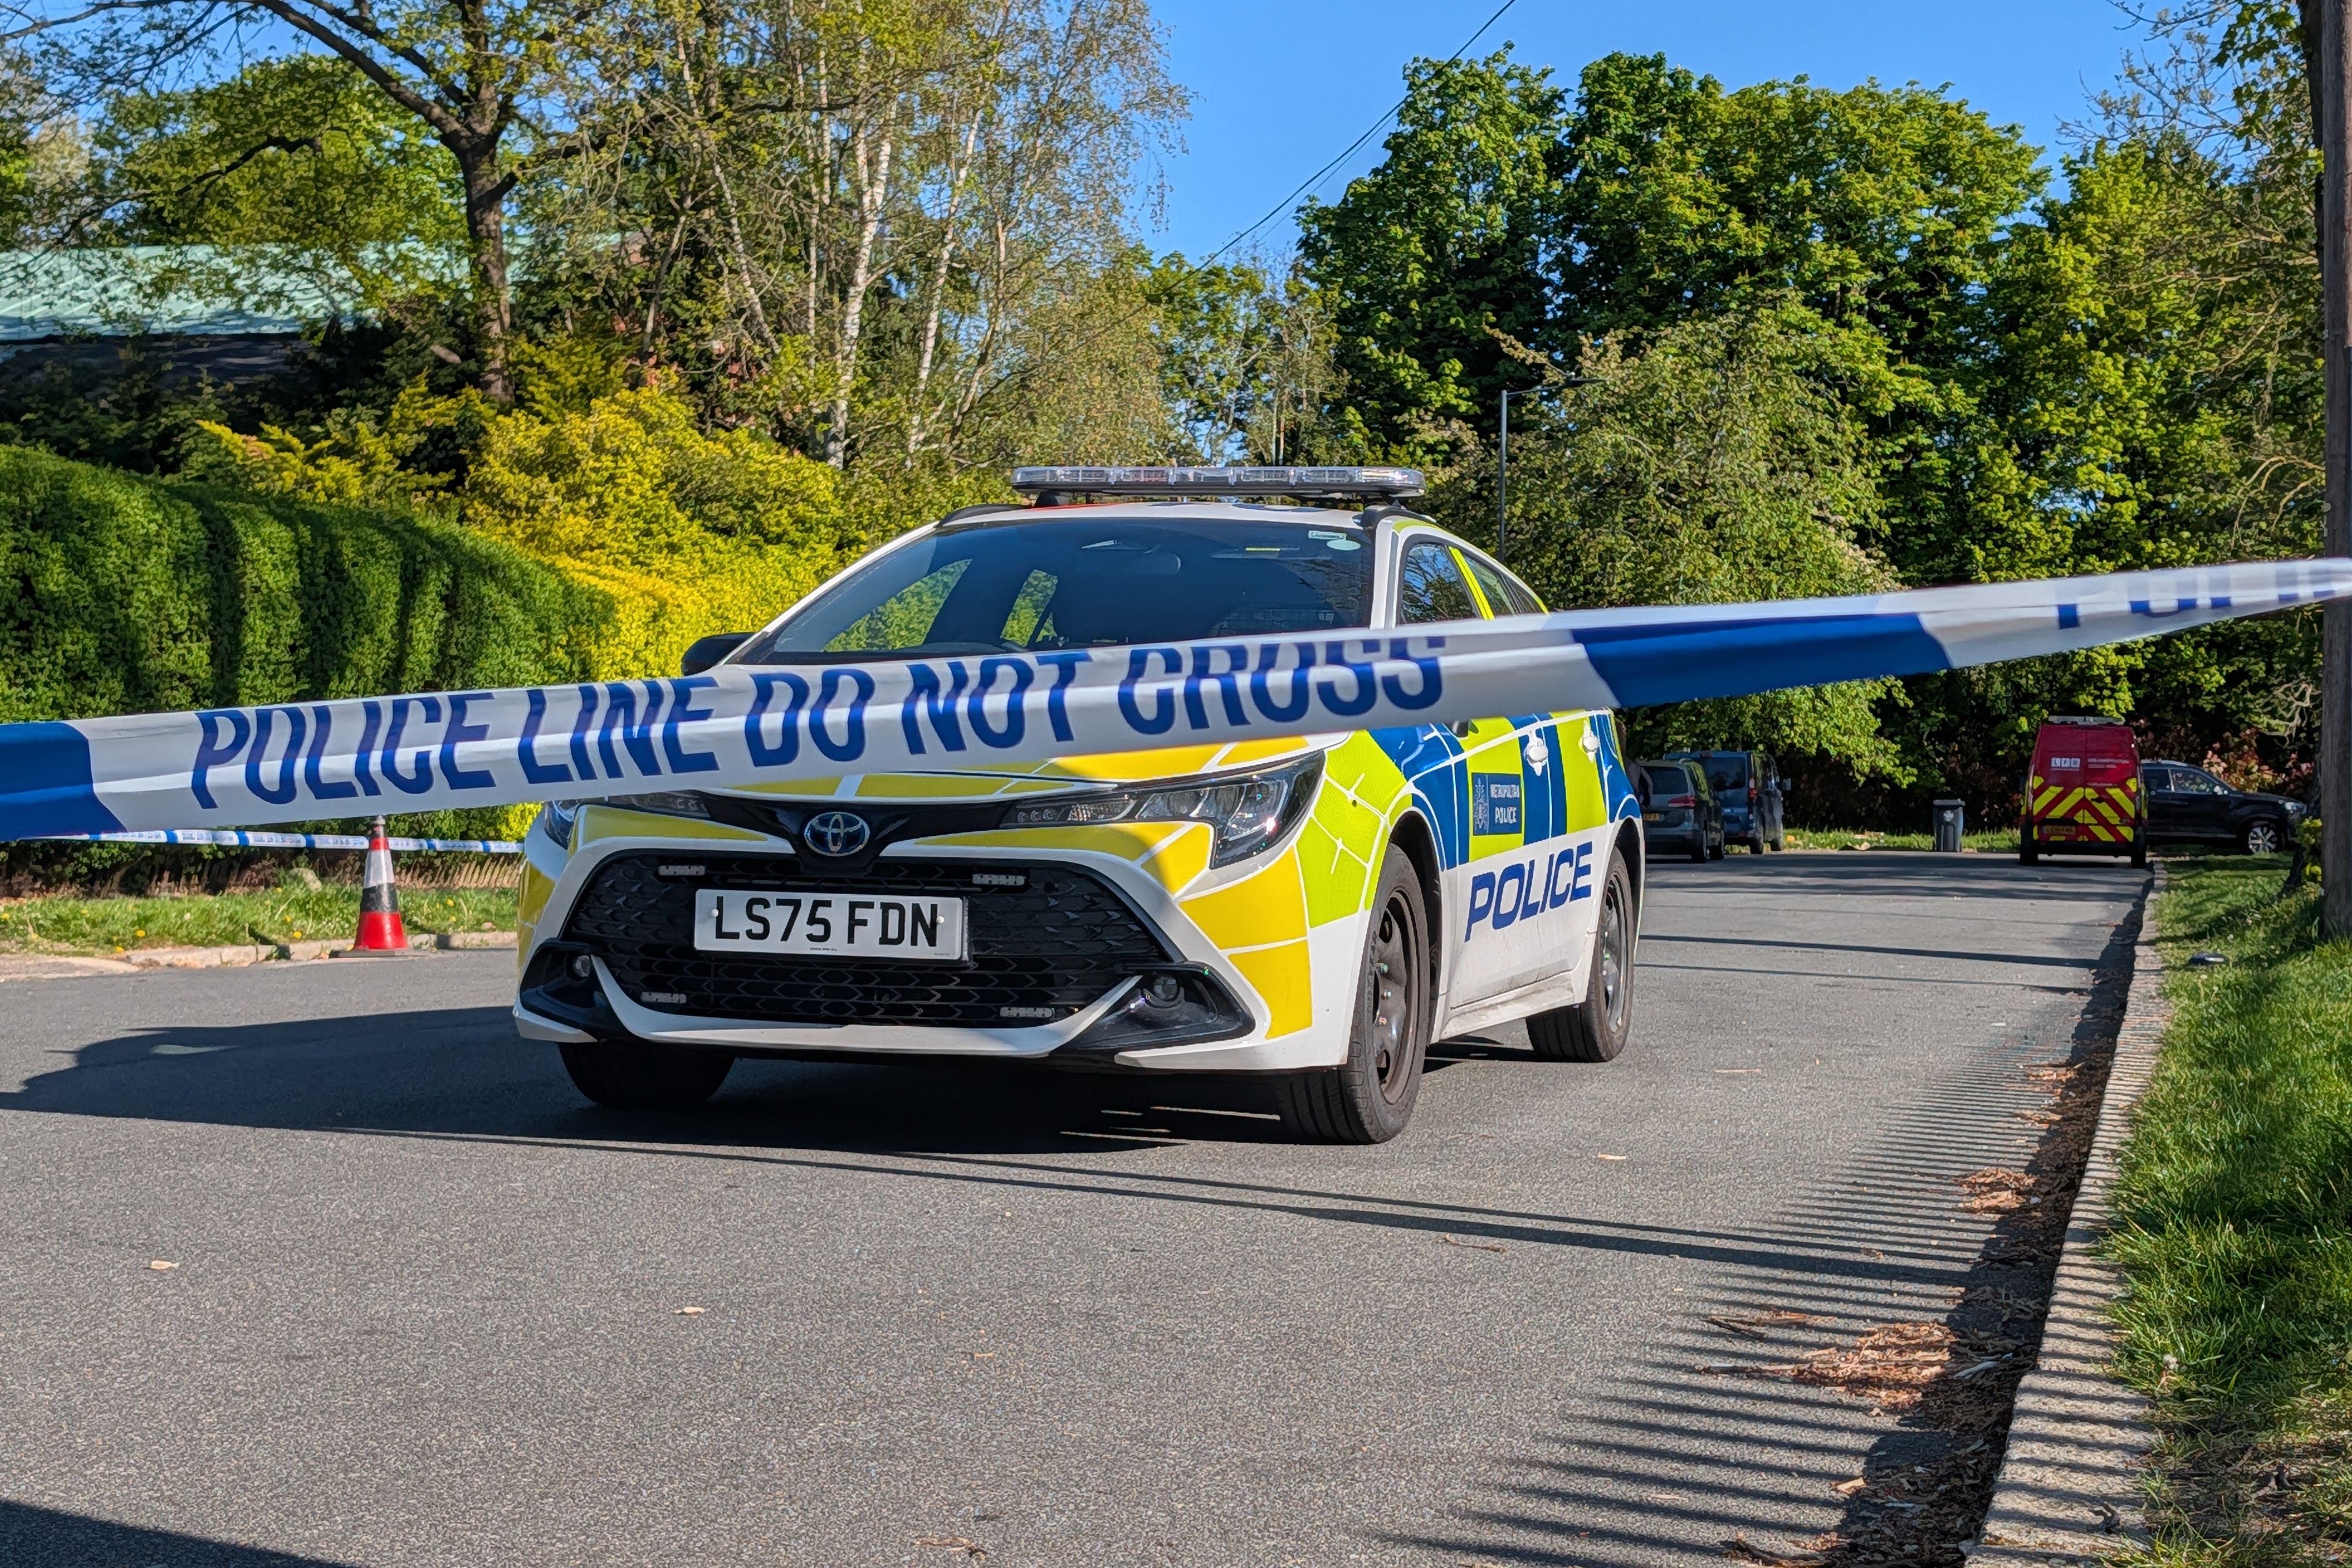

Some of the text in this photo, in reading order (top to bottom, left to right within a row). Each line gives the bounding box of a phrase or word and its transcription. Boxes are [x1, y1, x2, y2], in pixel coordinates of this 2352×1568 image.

[191, 637, 1445, 809] POLICE LINE DO NOT CROSS
[1495, 806, 1517, 824] POLICE
[715, 895, 938, 947] LS75 FDN
[1465, 842, 1592, 942] POLICE
